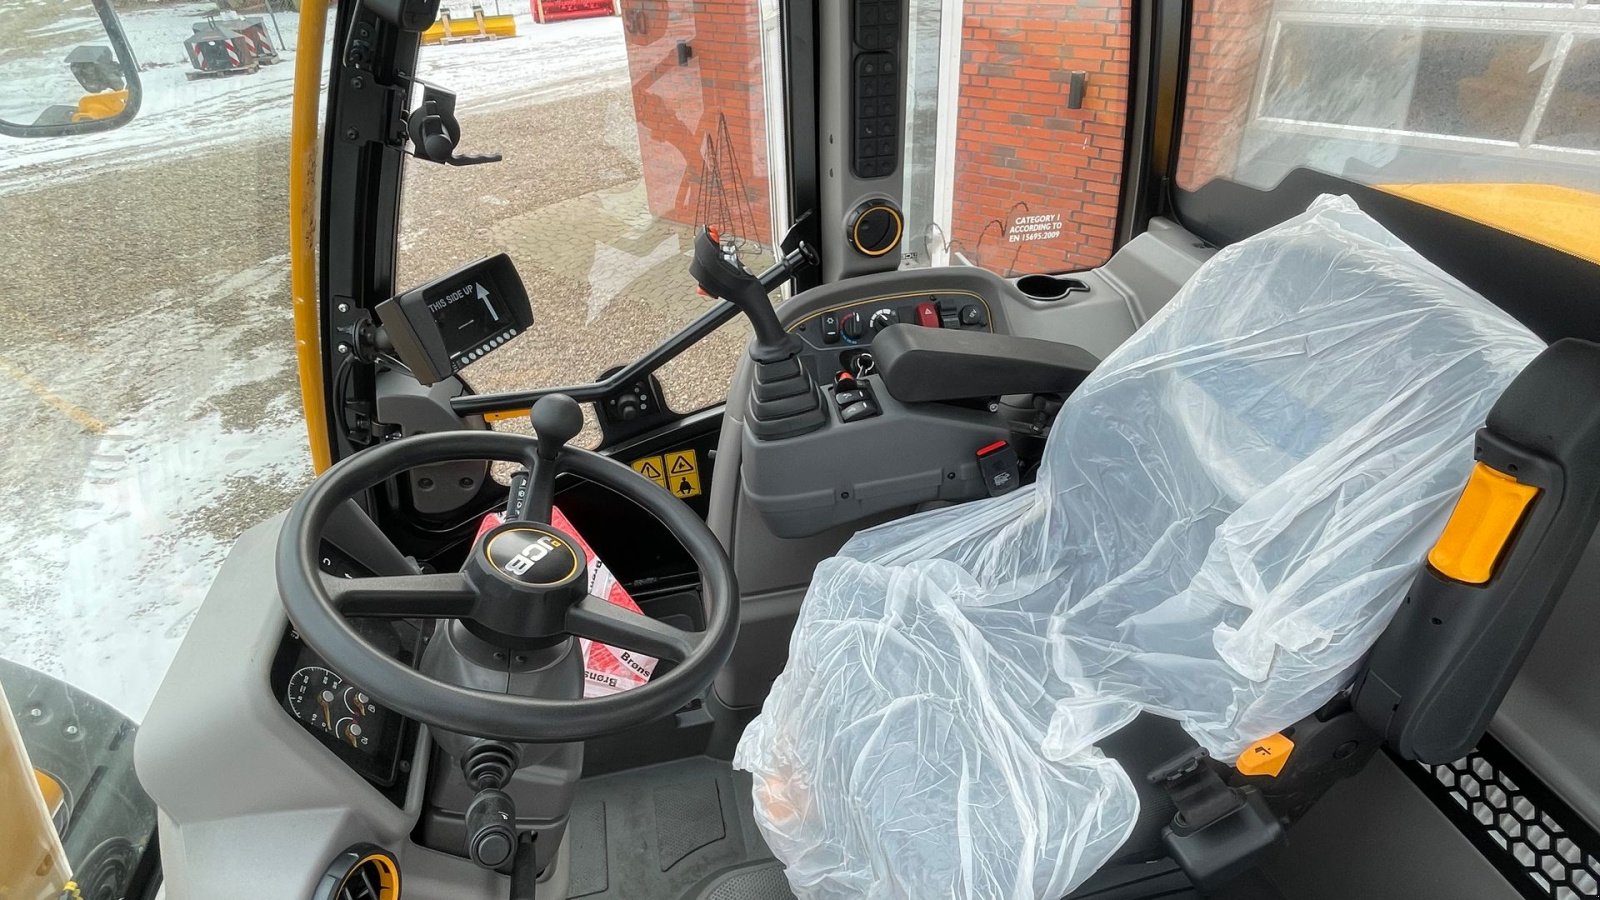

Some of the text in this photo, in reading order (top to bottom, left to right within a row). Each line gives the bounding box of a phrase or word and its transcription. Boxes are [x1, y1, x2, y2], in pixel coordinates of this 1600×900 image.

[1015, 214, 1056, 225] CATEGORY
[1009, 222, 1063, 234] ACCORDING TO
[1008, 230, 1060, 243] EN 15695:2009
[427, 284, 473, 313] THIS SIDE UP
[504, 536, 555, 576] JCB
